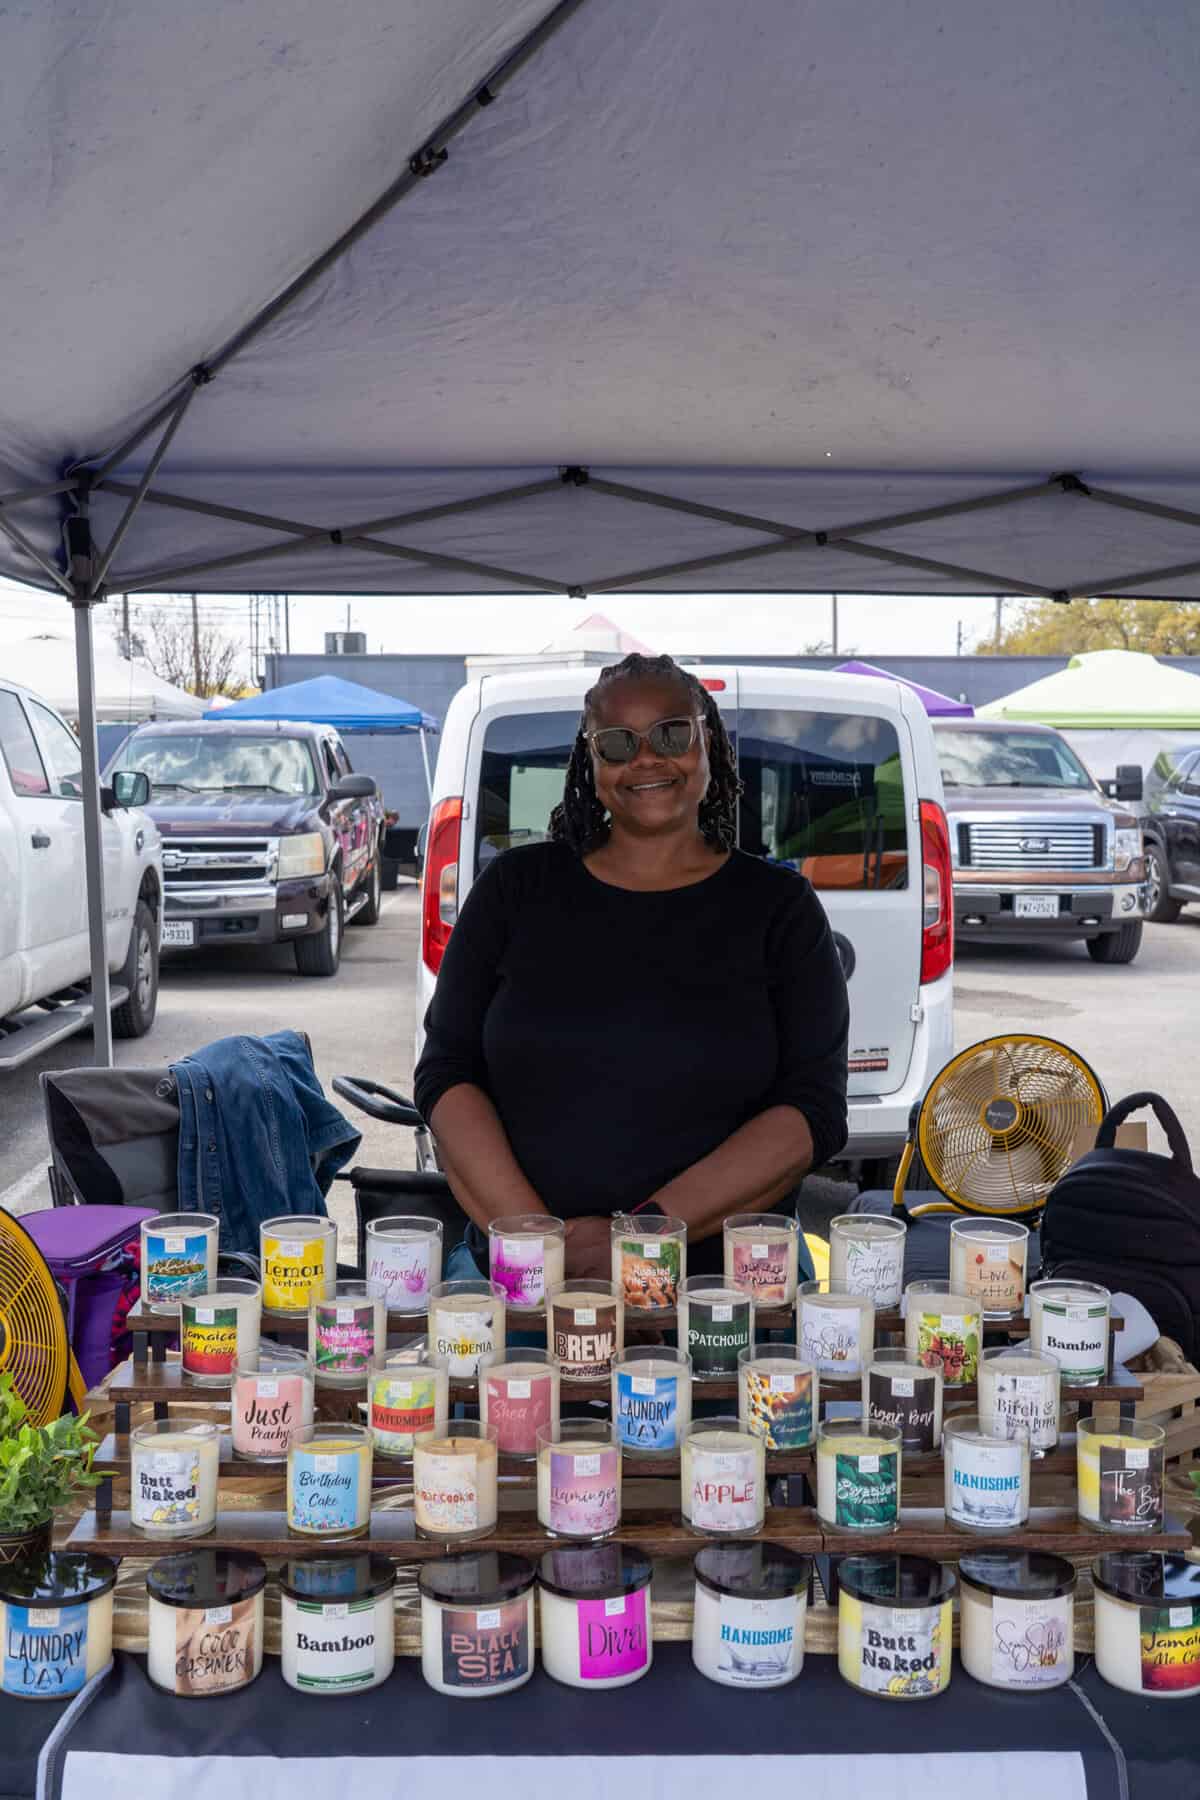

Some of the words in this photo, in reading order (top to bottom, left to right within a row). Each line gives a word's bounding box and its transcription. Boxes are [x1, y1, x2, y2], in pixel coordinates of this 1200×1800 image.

[263, 1257, 324, 1279] Lemon
[437, 1339, 493, 1355] GARDENIA
[556, 1331, 613, 1361] BREW
[688, 1329, 749, 1347] PATCHOULI
[1046, 1335, 1103, 1352] Bamboo
[244, 1399, 292, 1426] Just
[619, 1391, 672, 1425] LAUNDRY
[997, 1398, 1040, 1417] Birch
[250, 1426, 289, 1450] Peachy
[627, 1424, 658, 1439] DAY
[140, 1472, 173, 1488] Butt
[299, 1470, 352, 1489] Birthday
[953, 1469, 1021, 1492] HANDSOME
[1103, 1469, 1137, 1504] The
[141, 1485, 197, 1502] Naked
[308, 1492, 339, 1508] Cake
[694, 1480, 756, 1505] APPLE
[199, 1629, 241, 1657] COCO
[297, 1632, 375, 1653] Bamboo
[450, 1630, 521, 1655] BLACK
[587, 1623, 643, 1658] Diva
[720, 1625, 794, 1646] HANDSOME
[867, 1628, 918, 1652] Butt
[8, 1628, 84, 1670] LAUNDRY
[862, 1648, 935, 1673] Naked
[22, 1664, 69, 1687] DAY
[456, 1650, 515, 1678] SEA
